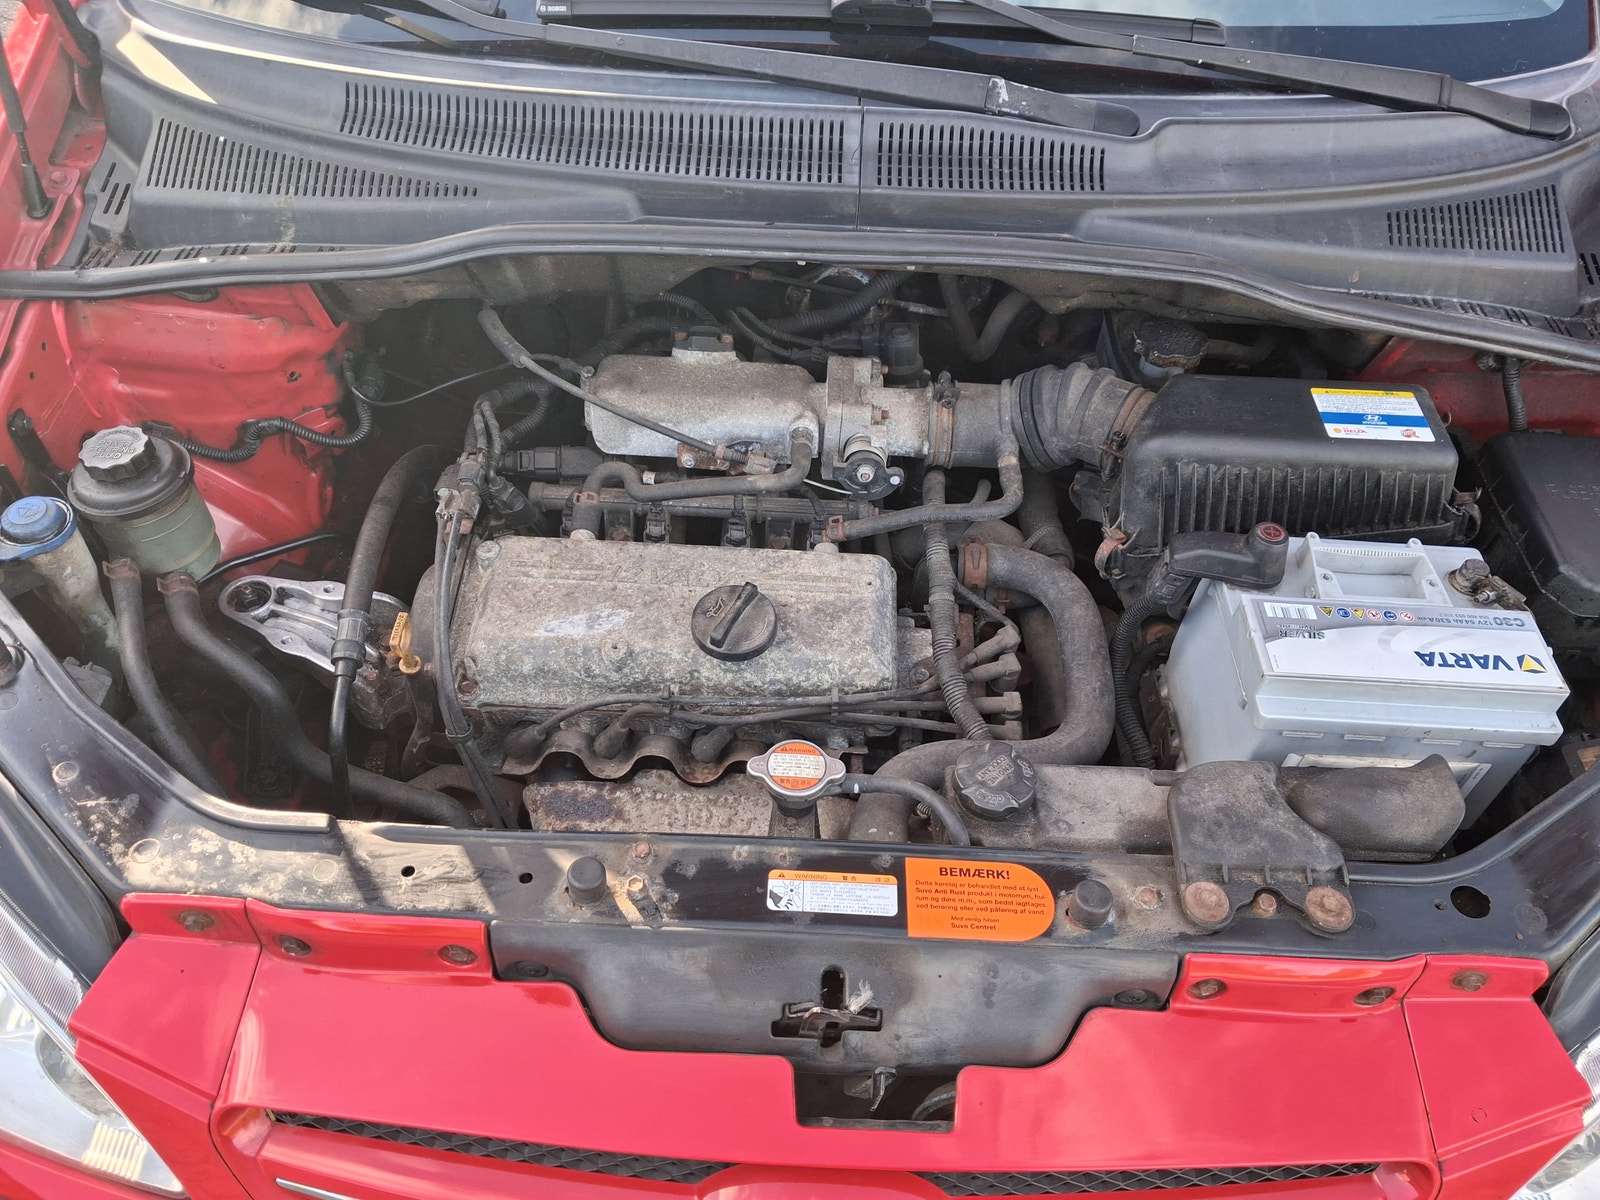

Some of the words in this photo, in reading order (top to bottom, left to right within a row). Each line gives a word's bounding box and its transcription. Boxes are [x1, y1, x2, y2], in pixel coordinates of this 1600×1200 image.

[86, 446, 136, 454] STEERING
[1493, 616, 1526, 628] C30
[1279, 630, 1326, 640] SILVER
[1414, 650, 1514, 671] VARTA
[977, 755, 1008, 780] COOLANT
[986, 762, 1014, 786] ENGINE
[940, 866, 1010, 880] BEMÆRK!
[990, 906, 1018, 914] påføring
[1016, 900, 1046, 908] iagttages
